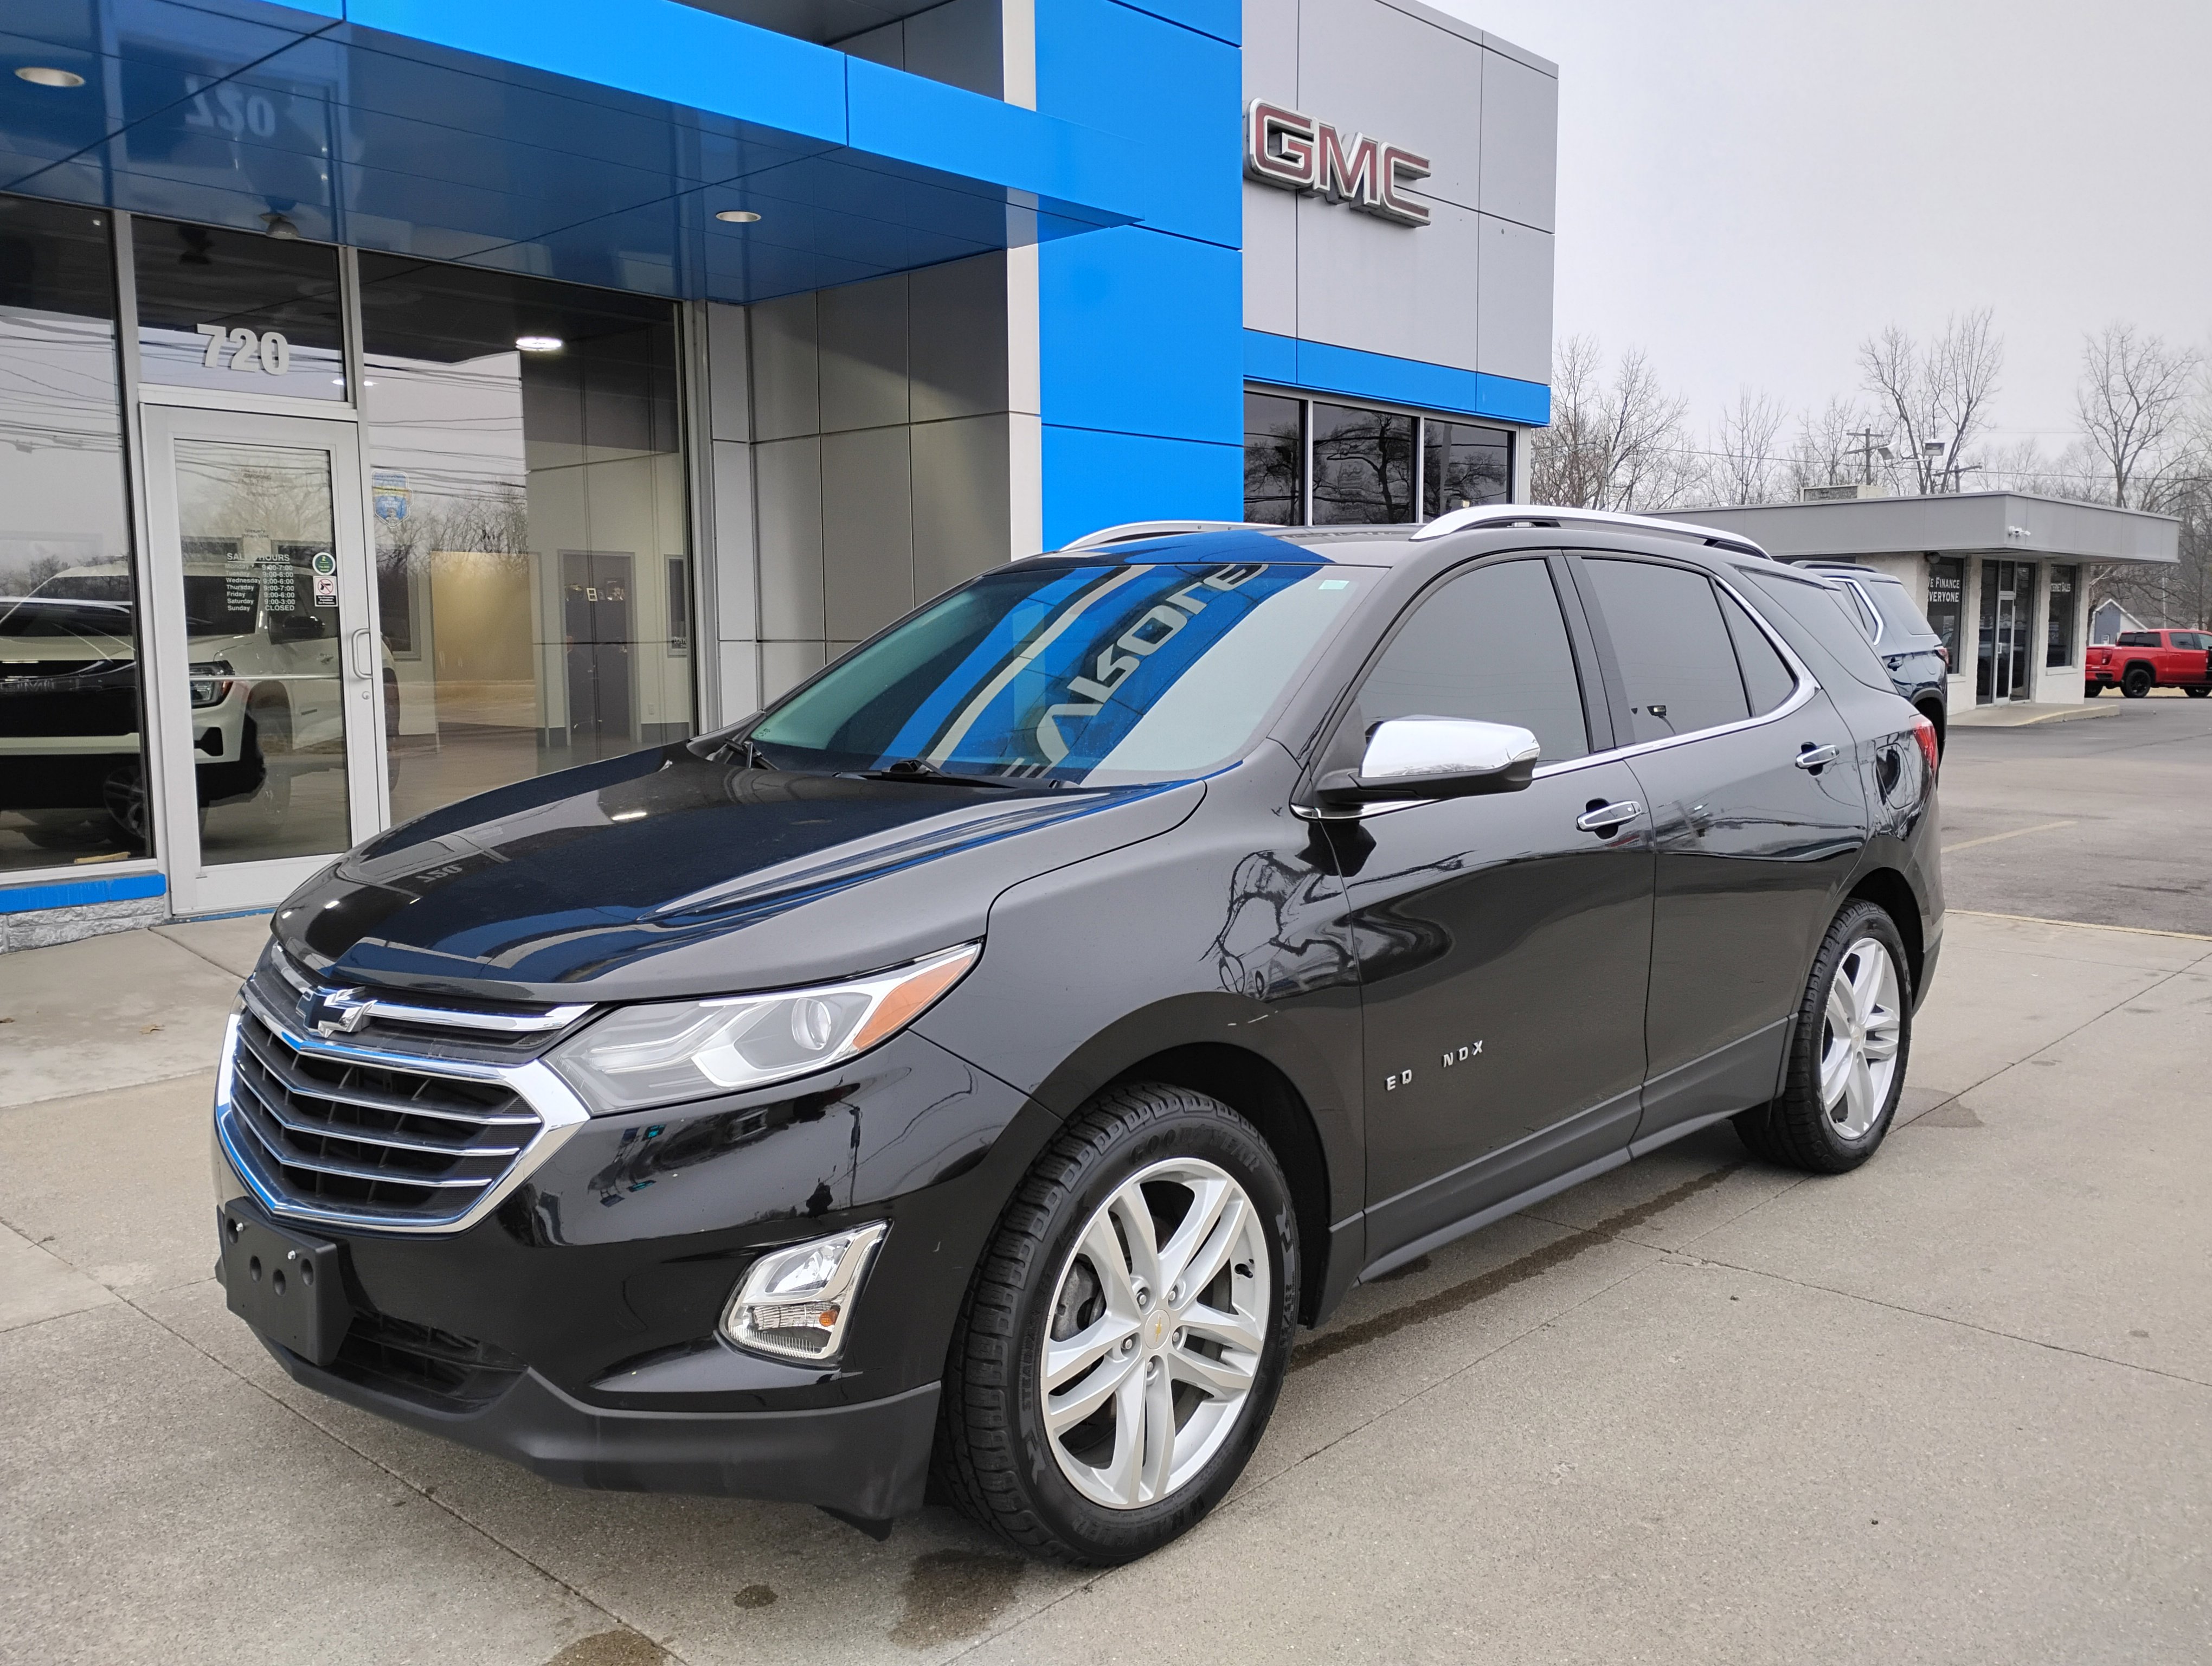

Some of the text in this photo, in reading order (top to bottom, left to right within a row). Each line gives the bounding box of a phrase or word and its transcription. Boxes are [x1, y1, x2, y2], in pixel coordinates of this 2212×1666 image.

[1245, 97, 1431, 228] GMC
[196, 323, 291, 376] 720
[227, 553, 249, 561] SAL
[1935, 576, 1960, 589] FINANCE
[1928, 591, 1960, 603] VERYONE
